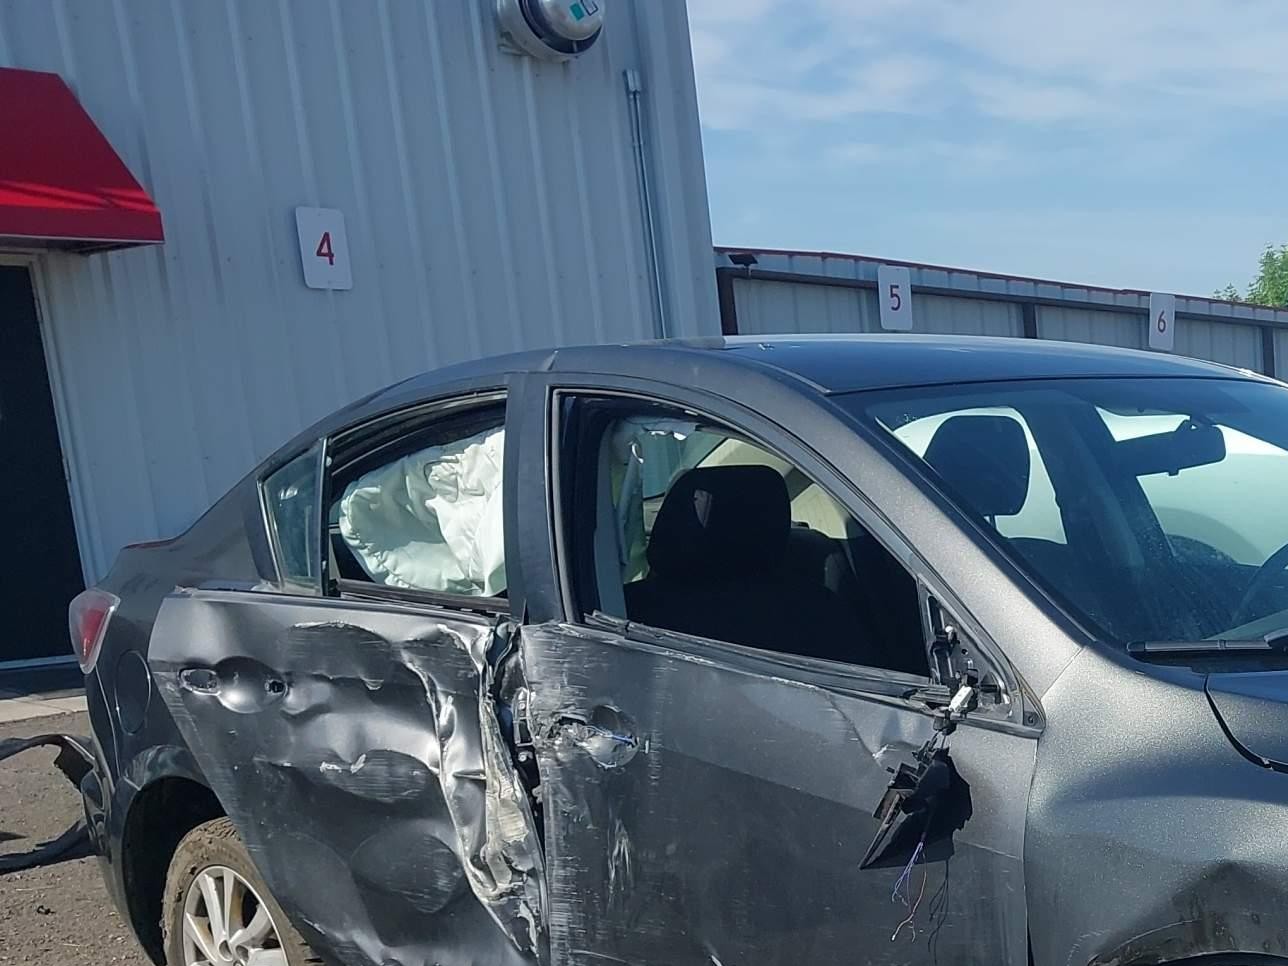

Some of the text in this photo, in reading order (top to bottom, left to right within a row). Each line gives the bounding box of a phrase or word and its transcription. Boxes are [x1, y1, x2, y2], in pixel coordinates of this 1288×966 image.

[316, 231, 335, 266] 4
[890, 284, 901, 311] 5
[1157, 310, 1167, 334] 6
